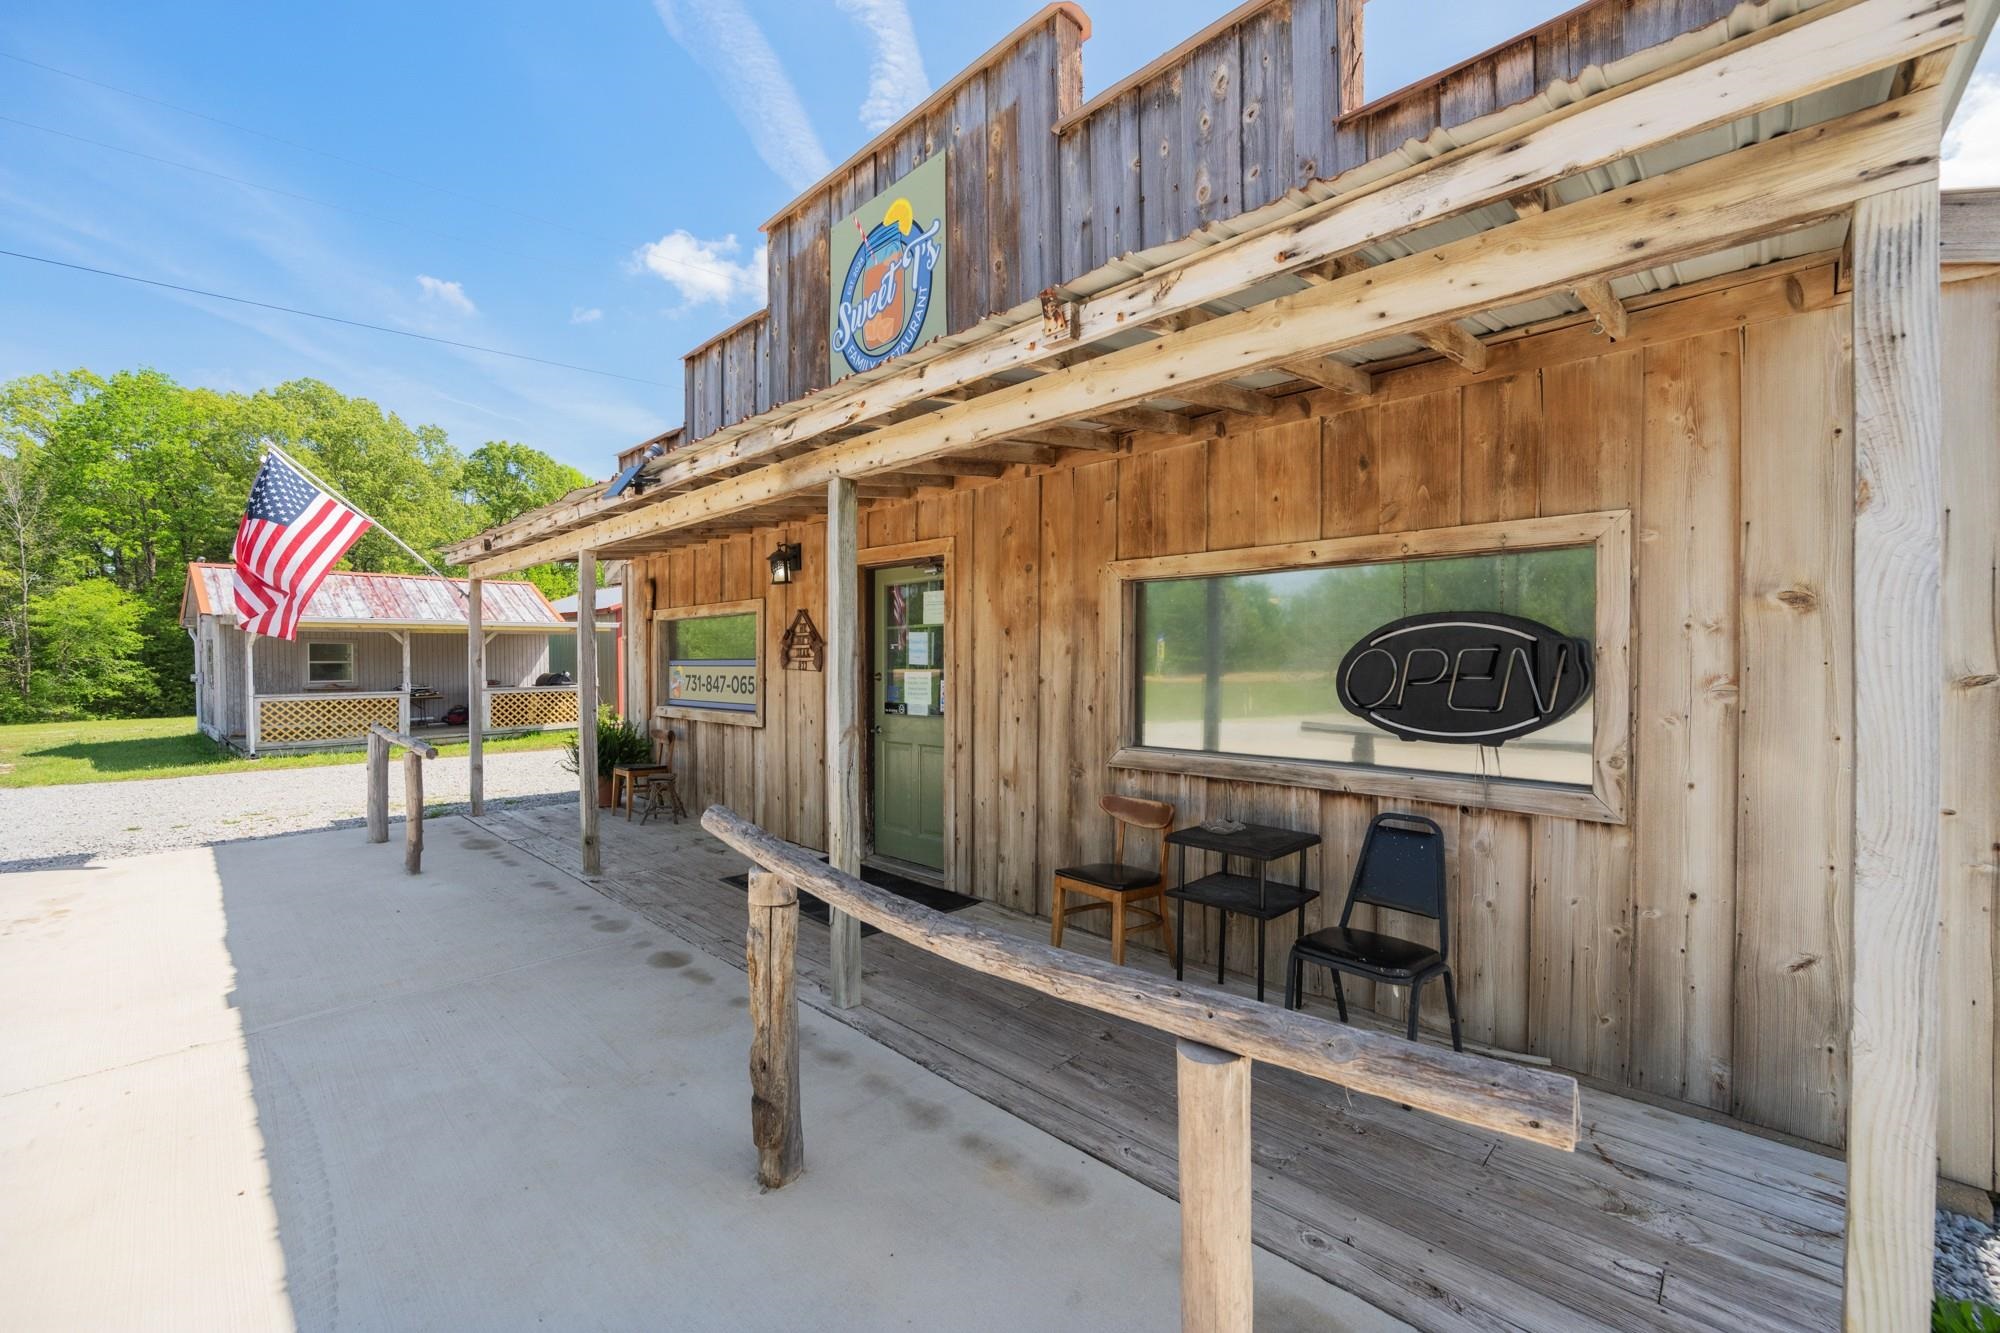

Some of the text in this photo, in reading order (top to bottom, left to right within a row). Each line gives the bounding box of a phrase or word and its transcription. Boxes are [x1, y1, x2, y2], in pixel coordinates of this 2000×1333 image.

[833, 221, 940, 351] Sweet T's
[877, 286, 928, 361] STAURANT
[685, 674, 755, 694] 731-847-065
[1345, 647, 1567, 713] OPEN
